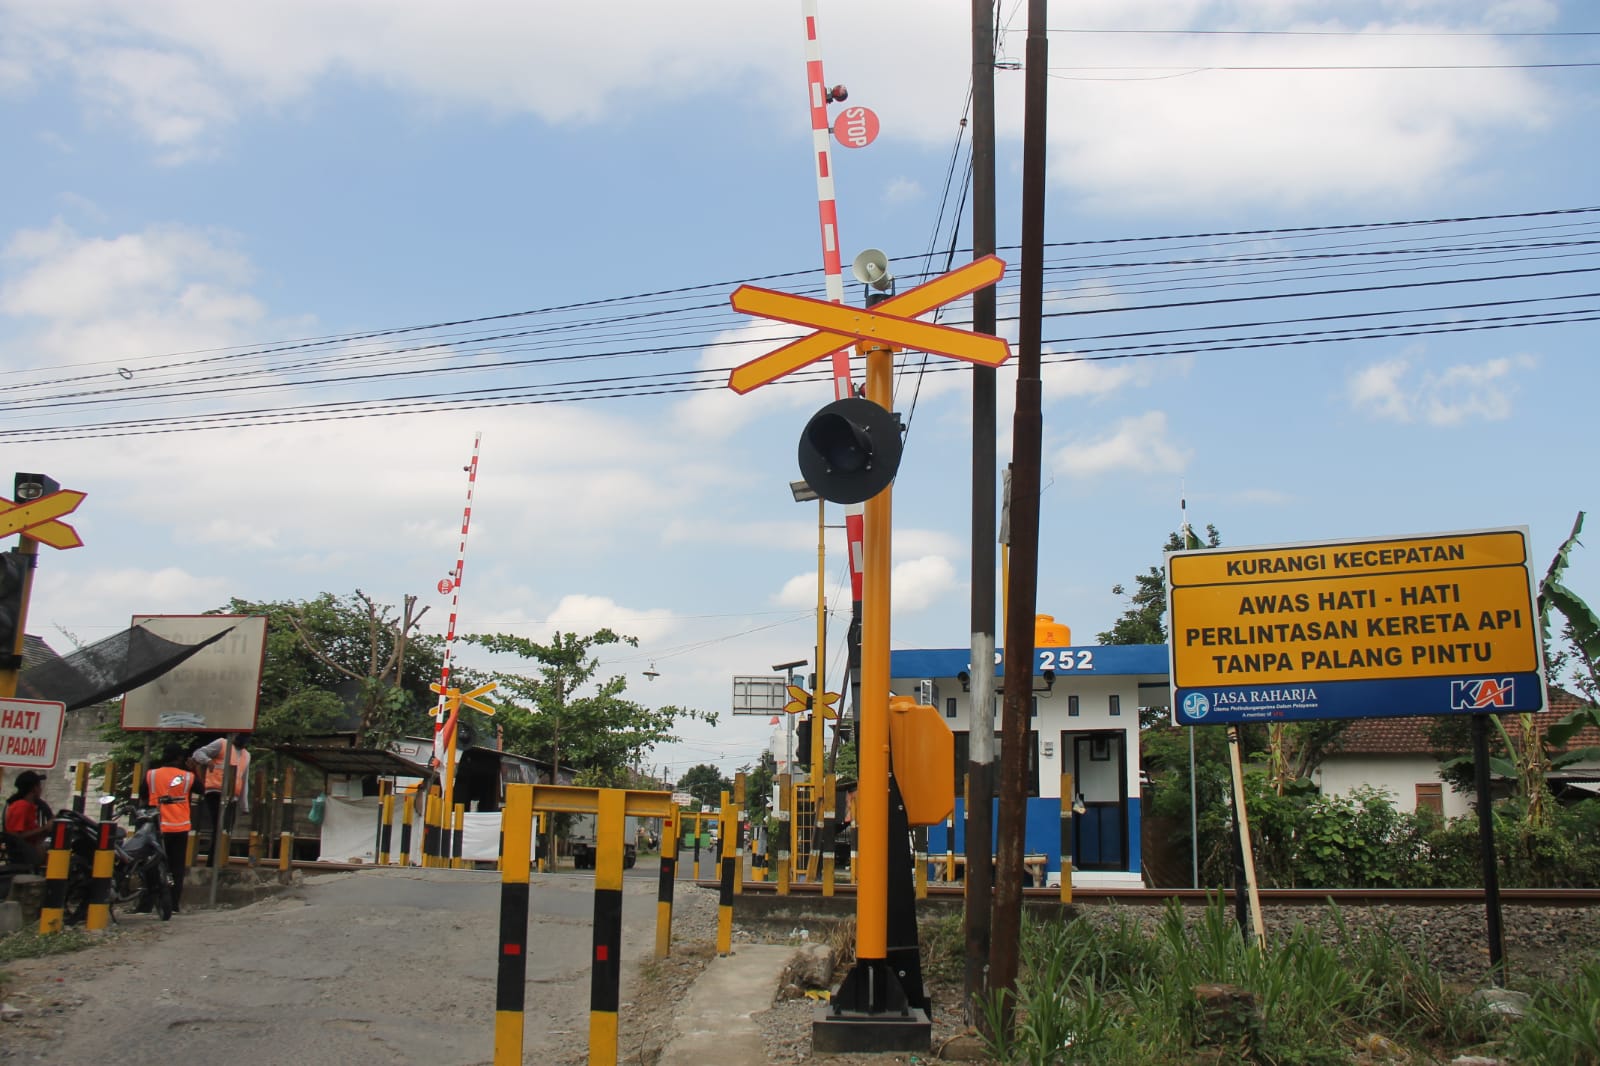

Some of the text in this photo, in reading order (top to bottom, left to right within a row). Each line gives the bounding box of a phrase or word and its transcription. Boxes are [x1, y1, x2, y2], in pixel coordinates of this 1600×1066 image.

[846, 108, 867, 146] STOP
[1226, 544, 1464, 576] KURANGI KECEPATAN
[1238, 593, 1310, 615] AWAS
[1318, 589, 1377, 611] HATI
[1400, 584, 1460, 606] HATI
[1186, 609, 1522, 646] PERLINTASAN KERETA API
[1040, 650, 1093, 670] 252
[1212, 642, 1492, 674] TANPA PALANG PINTU
[1213, 688, 1318, 706] JASA RAHARJA
[1451, 677, 1514, 709] KAI
[1, 710, 41, 730] HATI
[6, 736, 47, 757] PADAM
